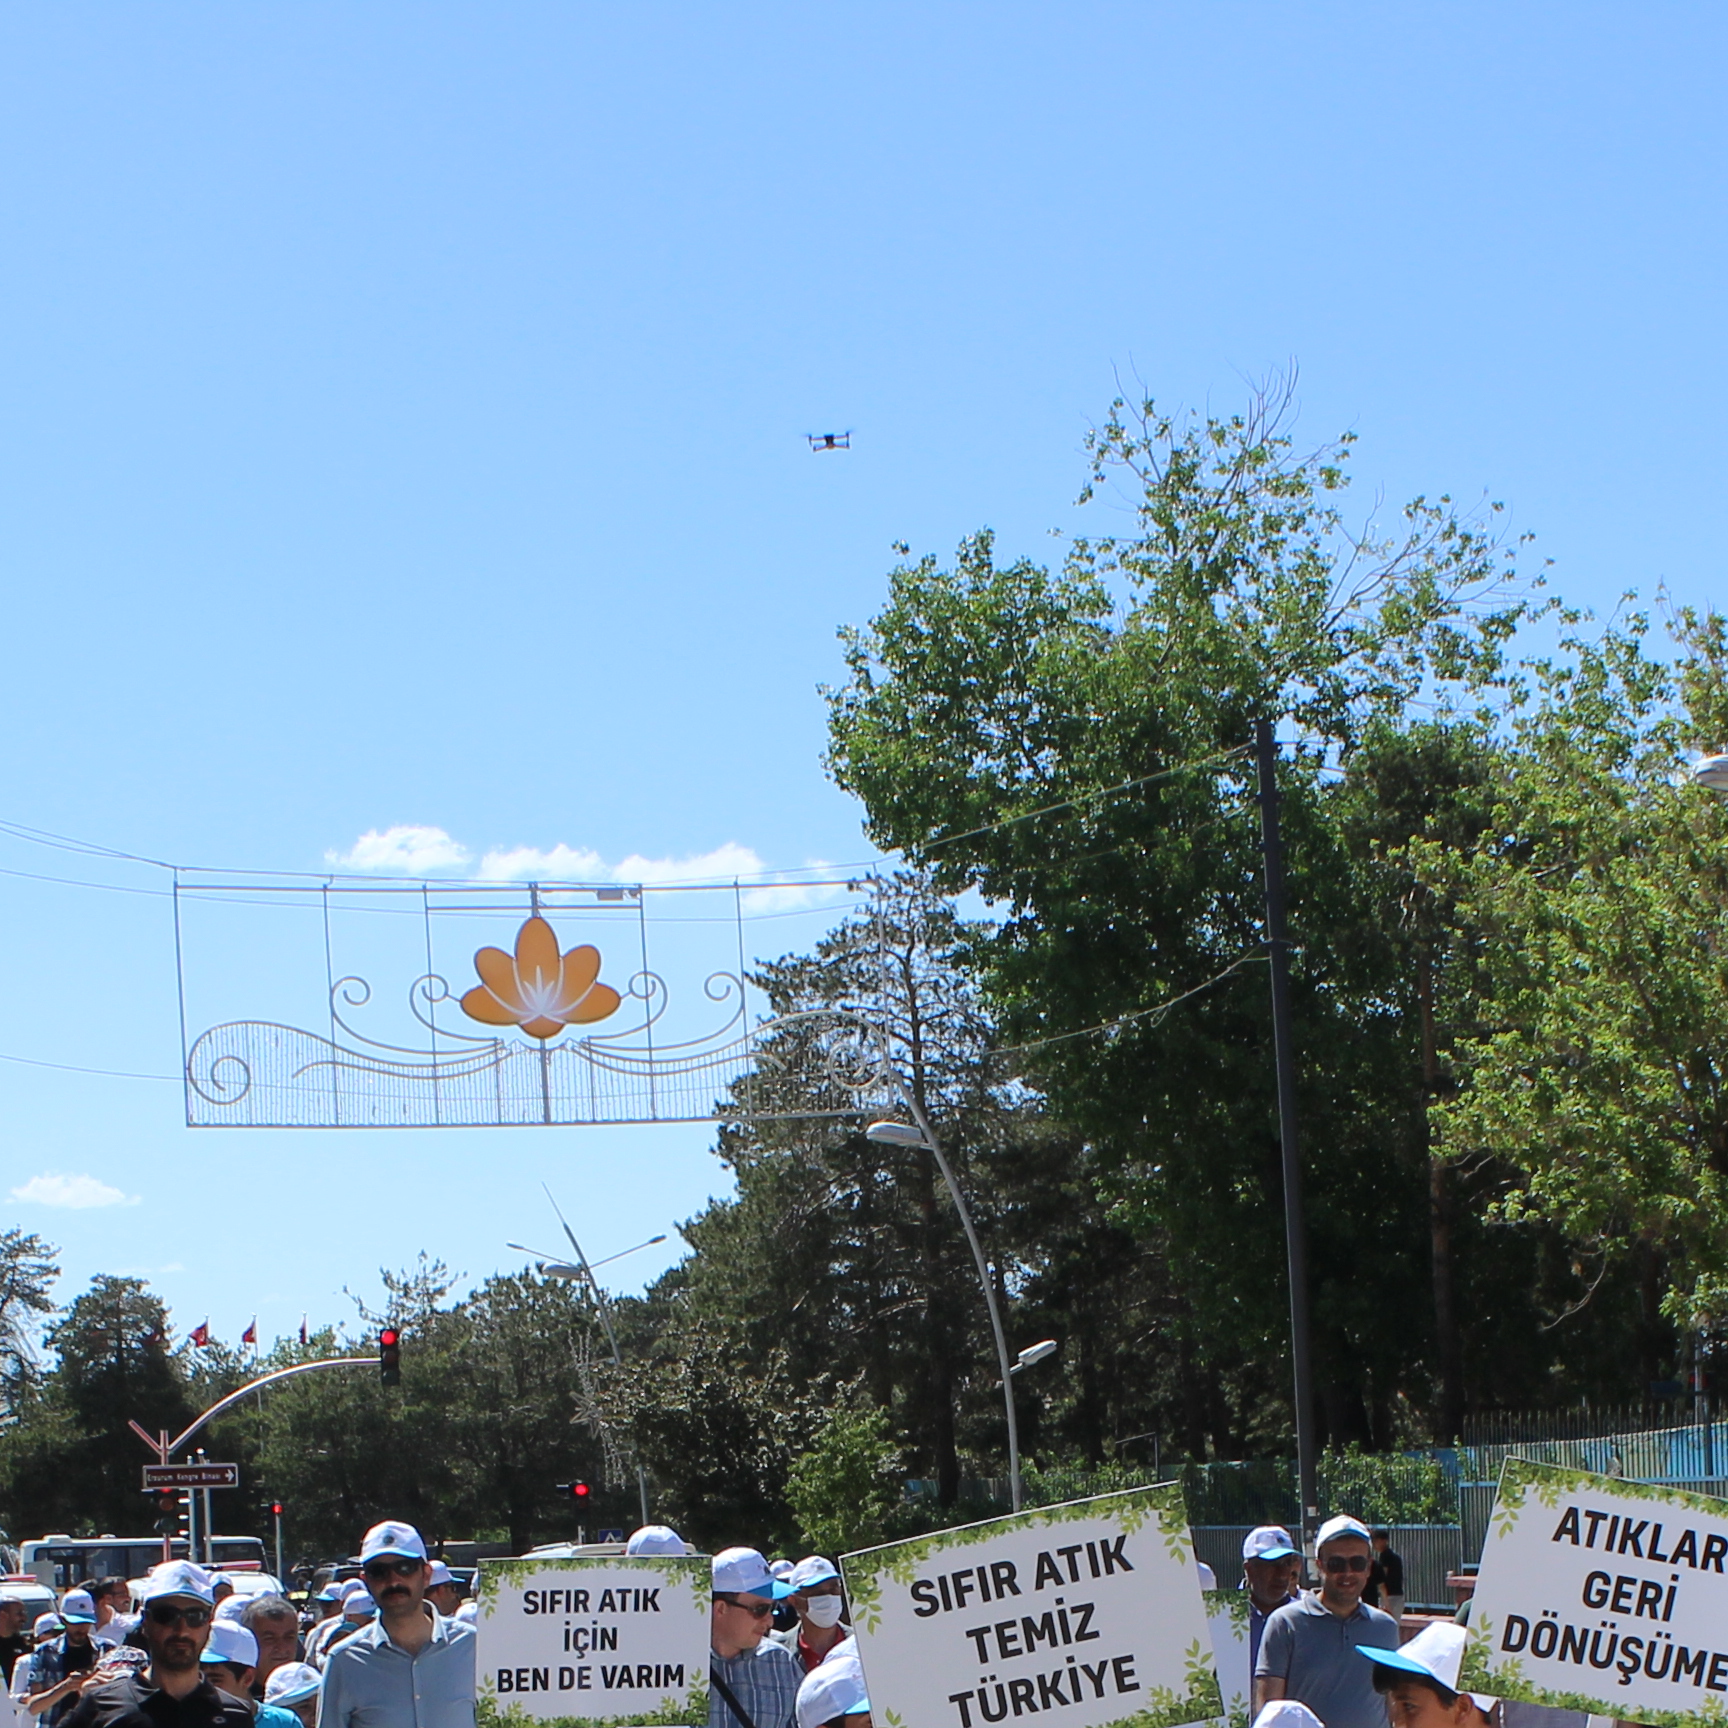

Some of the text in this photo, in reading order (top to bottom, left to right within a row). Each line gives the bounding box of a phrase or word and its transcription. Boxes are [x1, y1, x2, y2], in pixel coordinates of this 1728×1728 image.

[1551, 1506, 1728, 1574] ATIKLAR
[523, 1588, 661, 1615] SIFIR ATIK
[910, 1534, 1135, 1618] SIFIR ATIK
[1582, 1571, 1680, 1622] GERİ
[564, 1620, 617, 1659] İÇİN
[965, 1597, 1100, 1665] TEMİZ
[497, 1664, 684, 1693] BEN DE VARIM
[948, 1654, 1141, 1728] TÜRKİYE
